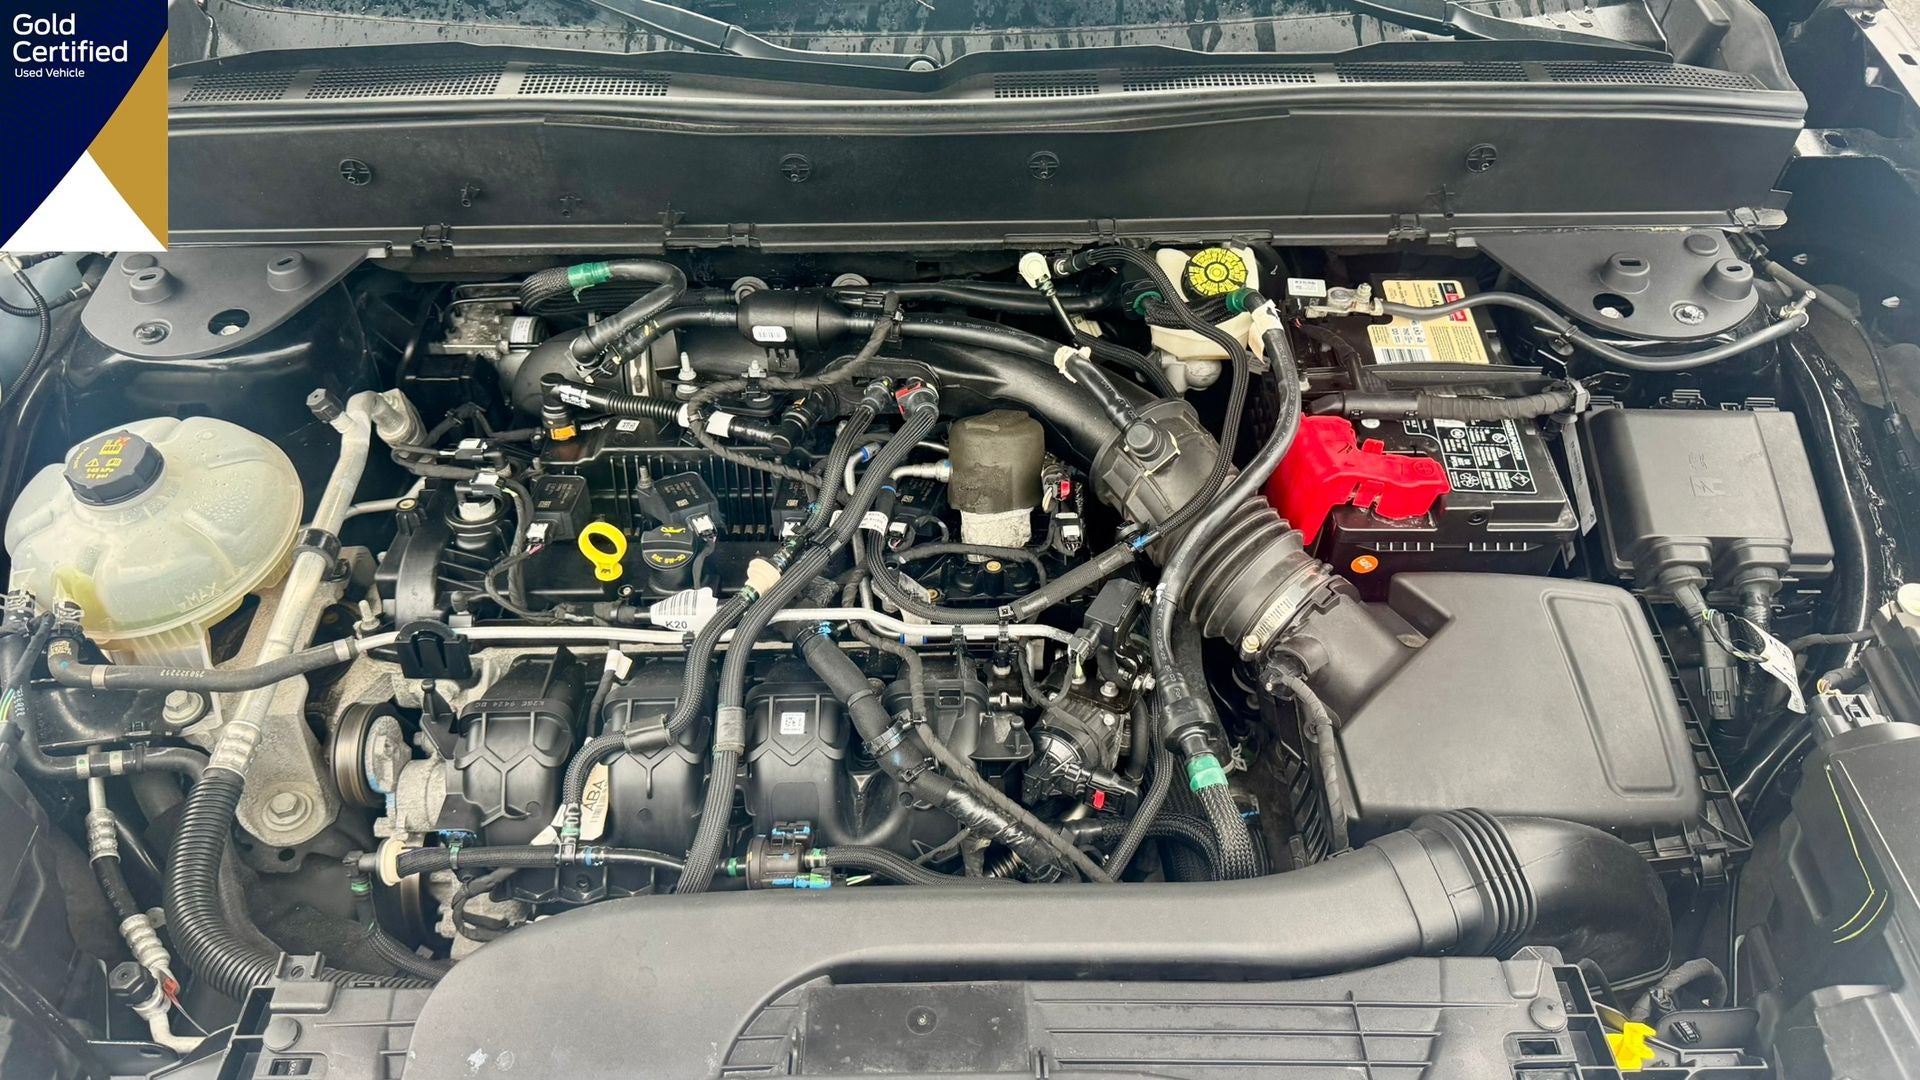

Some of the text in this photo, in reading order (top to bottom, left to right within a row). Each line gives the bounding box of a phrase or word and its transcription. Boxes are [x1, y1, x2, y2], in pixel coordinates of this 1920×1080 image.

[184, 582, 221, 606] MAX
[665, 620, 688, 629] K20
[583, 780, 605, 812] ABA
